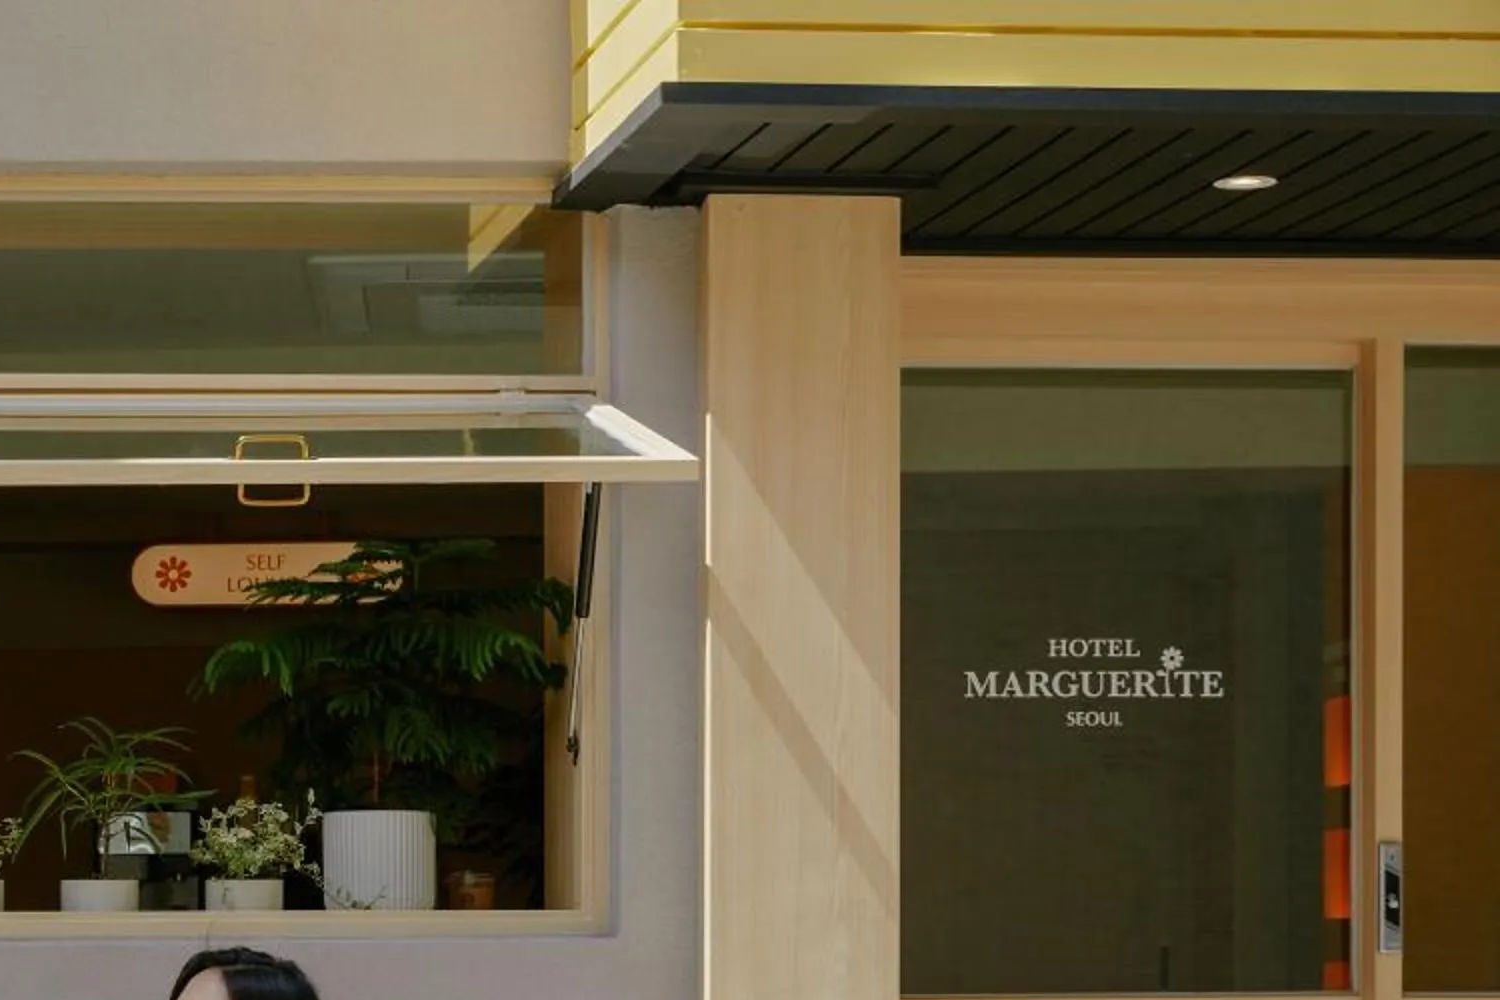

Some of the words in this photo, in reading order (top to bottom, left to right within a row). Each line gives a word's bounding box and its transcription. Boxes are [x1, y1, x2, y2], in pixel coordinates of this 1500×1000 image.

[246, 554, 286, 571] SELF
[1048, 638, 1141, 657] HOTEL
[963, 669, 1225, 698] MARGUERITE
[1065, 711, 1123, 727] SEOUL
